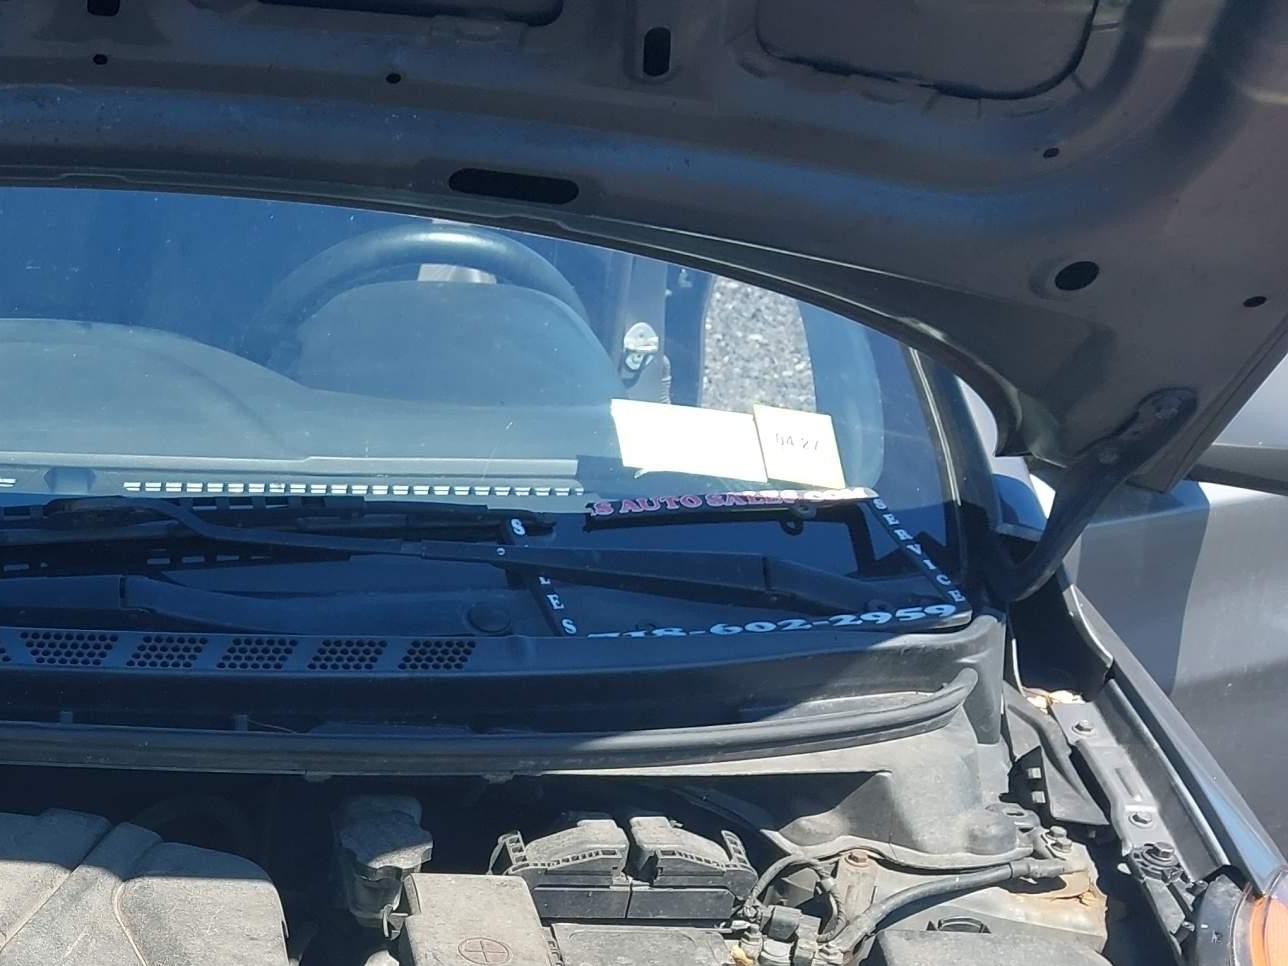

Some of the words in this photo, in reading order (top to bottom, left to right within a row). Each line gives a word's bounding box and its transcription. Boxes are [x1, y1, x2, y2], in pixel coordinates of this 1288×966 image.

[619, 495, 703, 514] AUTO
[872, 498, 966, 602] SERVICE
[511, 518, 577, 634] SLES
